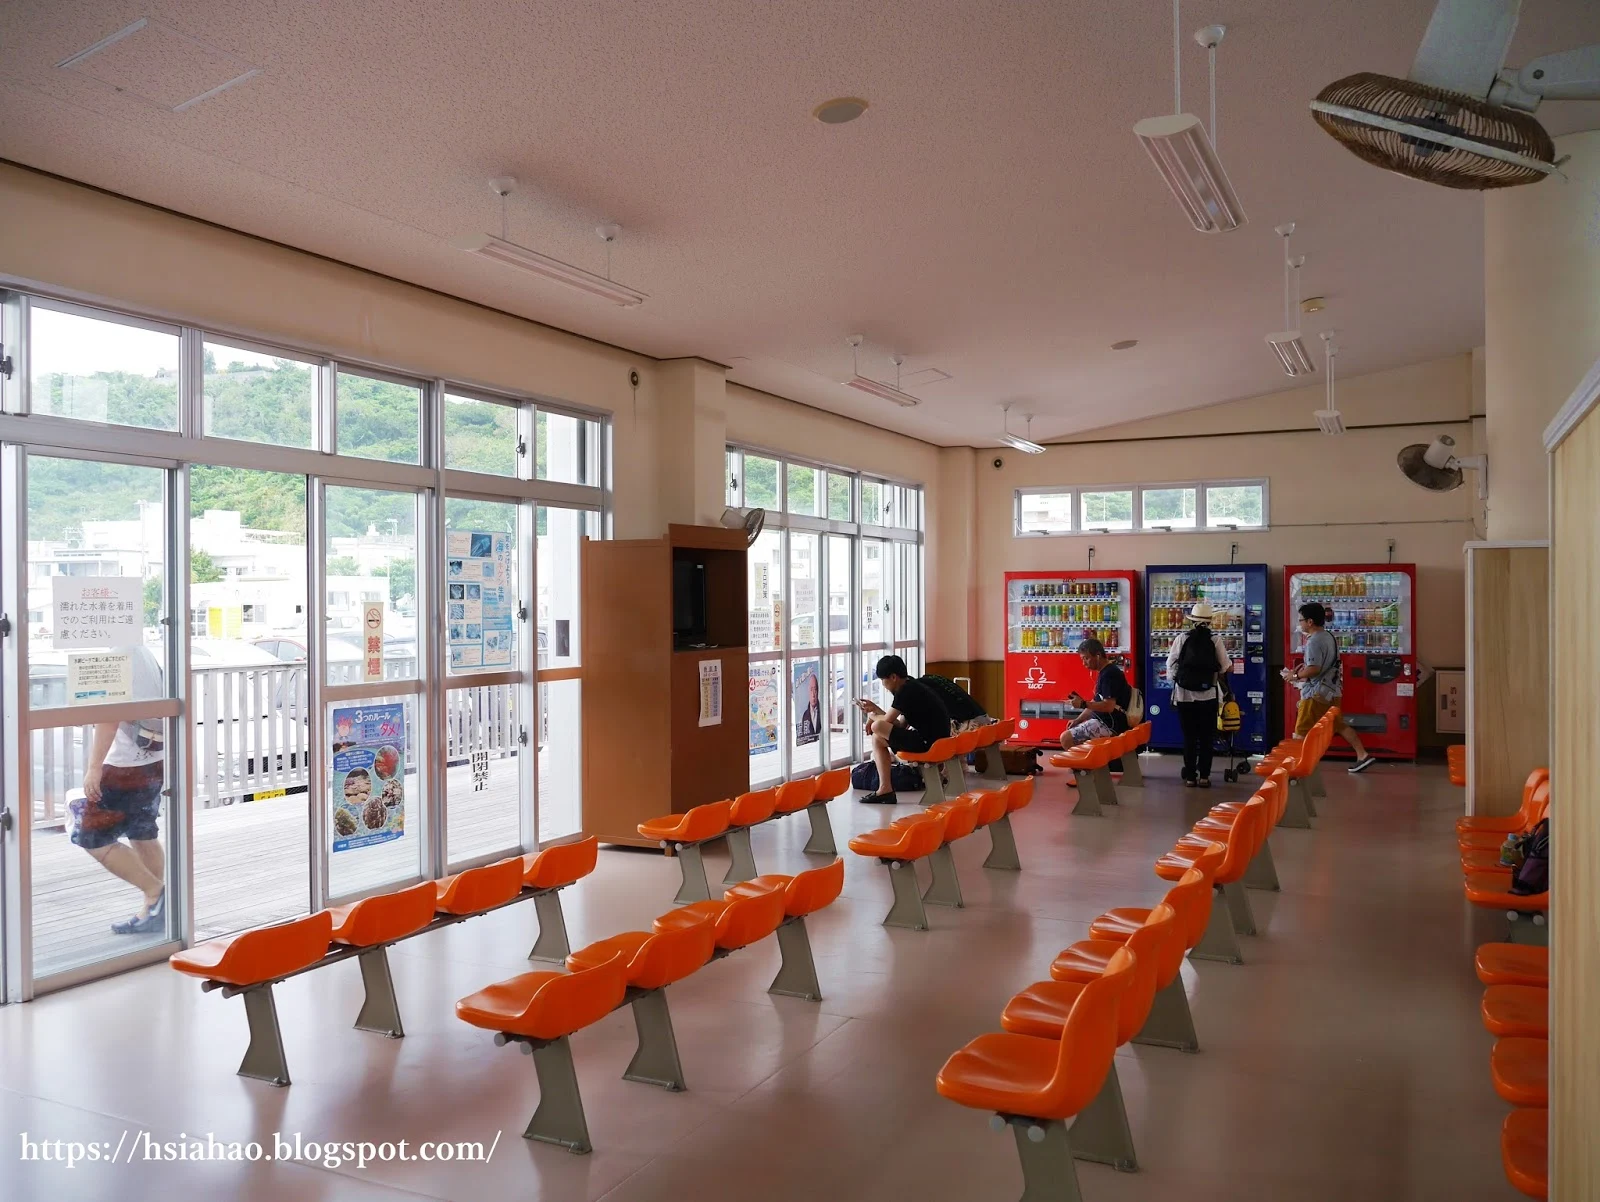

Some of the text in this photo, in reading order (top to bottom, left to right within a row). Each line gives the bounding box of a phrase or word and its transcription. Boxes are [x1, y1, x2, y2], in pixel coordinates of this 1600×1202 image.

[81, 587, 118, 597] お客様へ
[60, 601, 133, 611] 濡れた水着を着用
[60, 614, 133, 625] でのご利用はご遠
[60, 629, 111, 639] 慮ください。
[774, 622, 781, 646] 禁煙
[368, 636, 380, 675] 禁煙
[355, 709, 391, 724] 3つのルール
[380, 720, 401, 737] ダメ!
[472, 751, 488, 792] 開閉禁止
